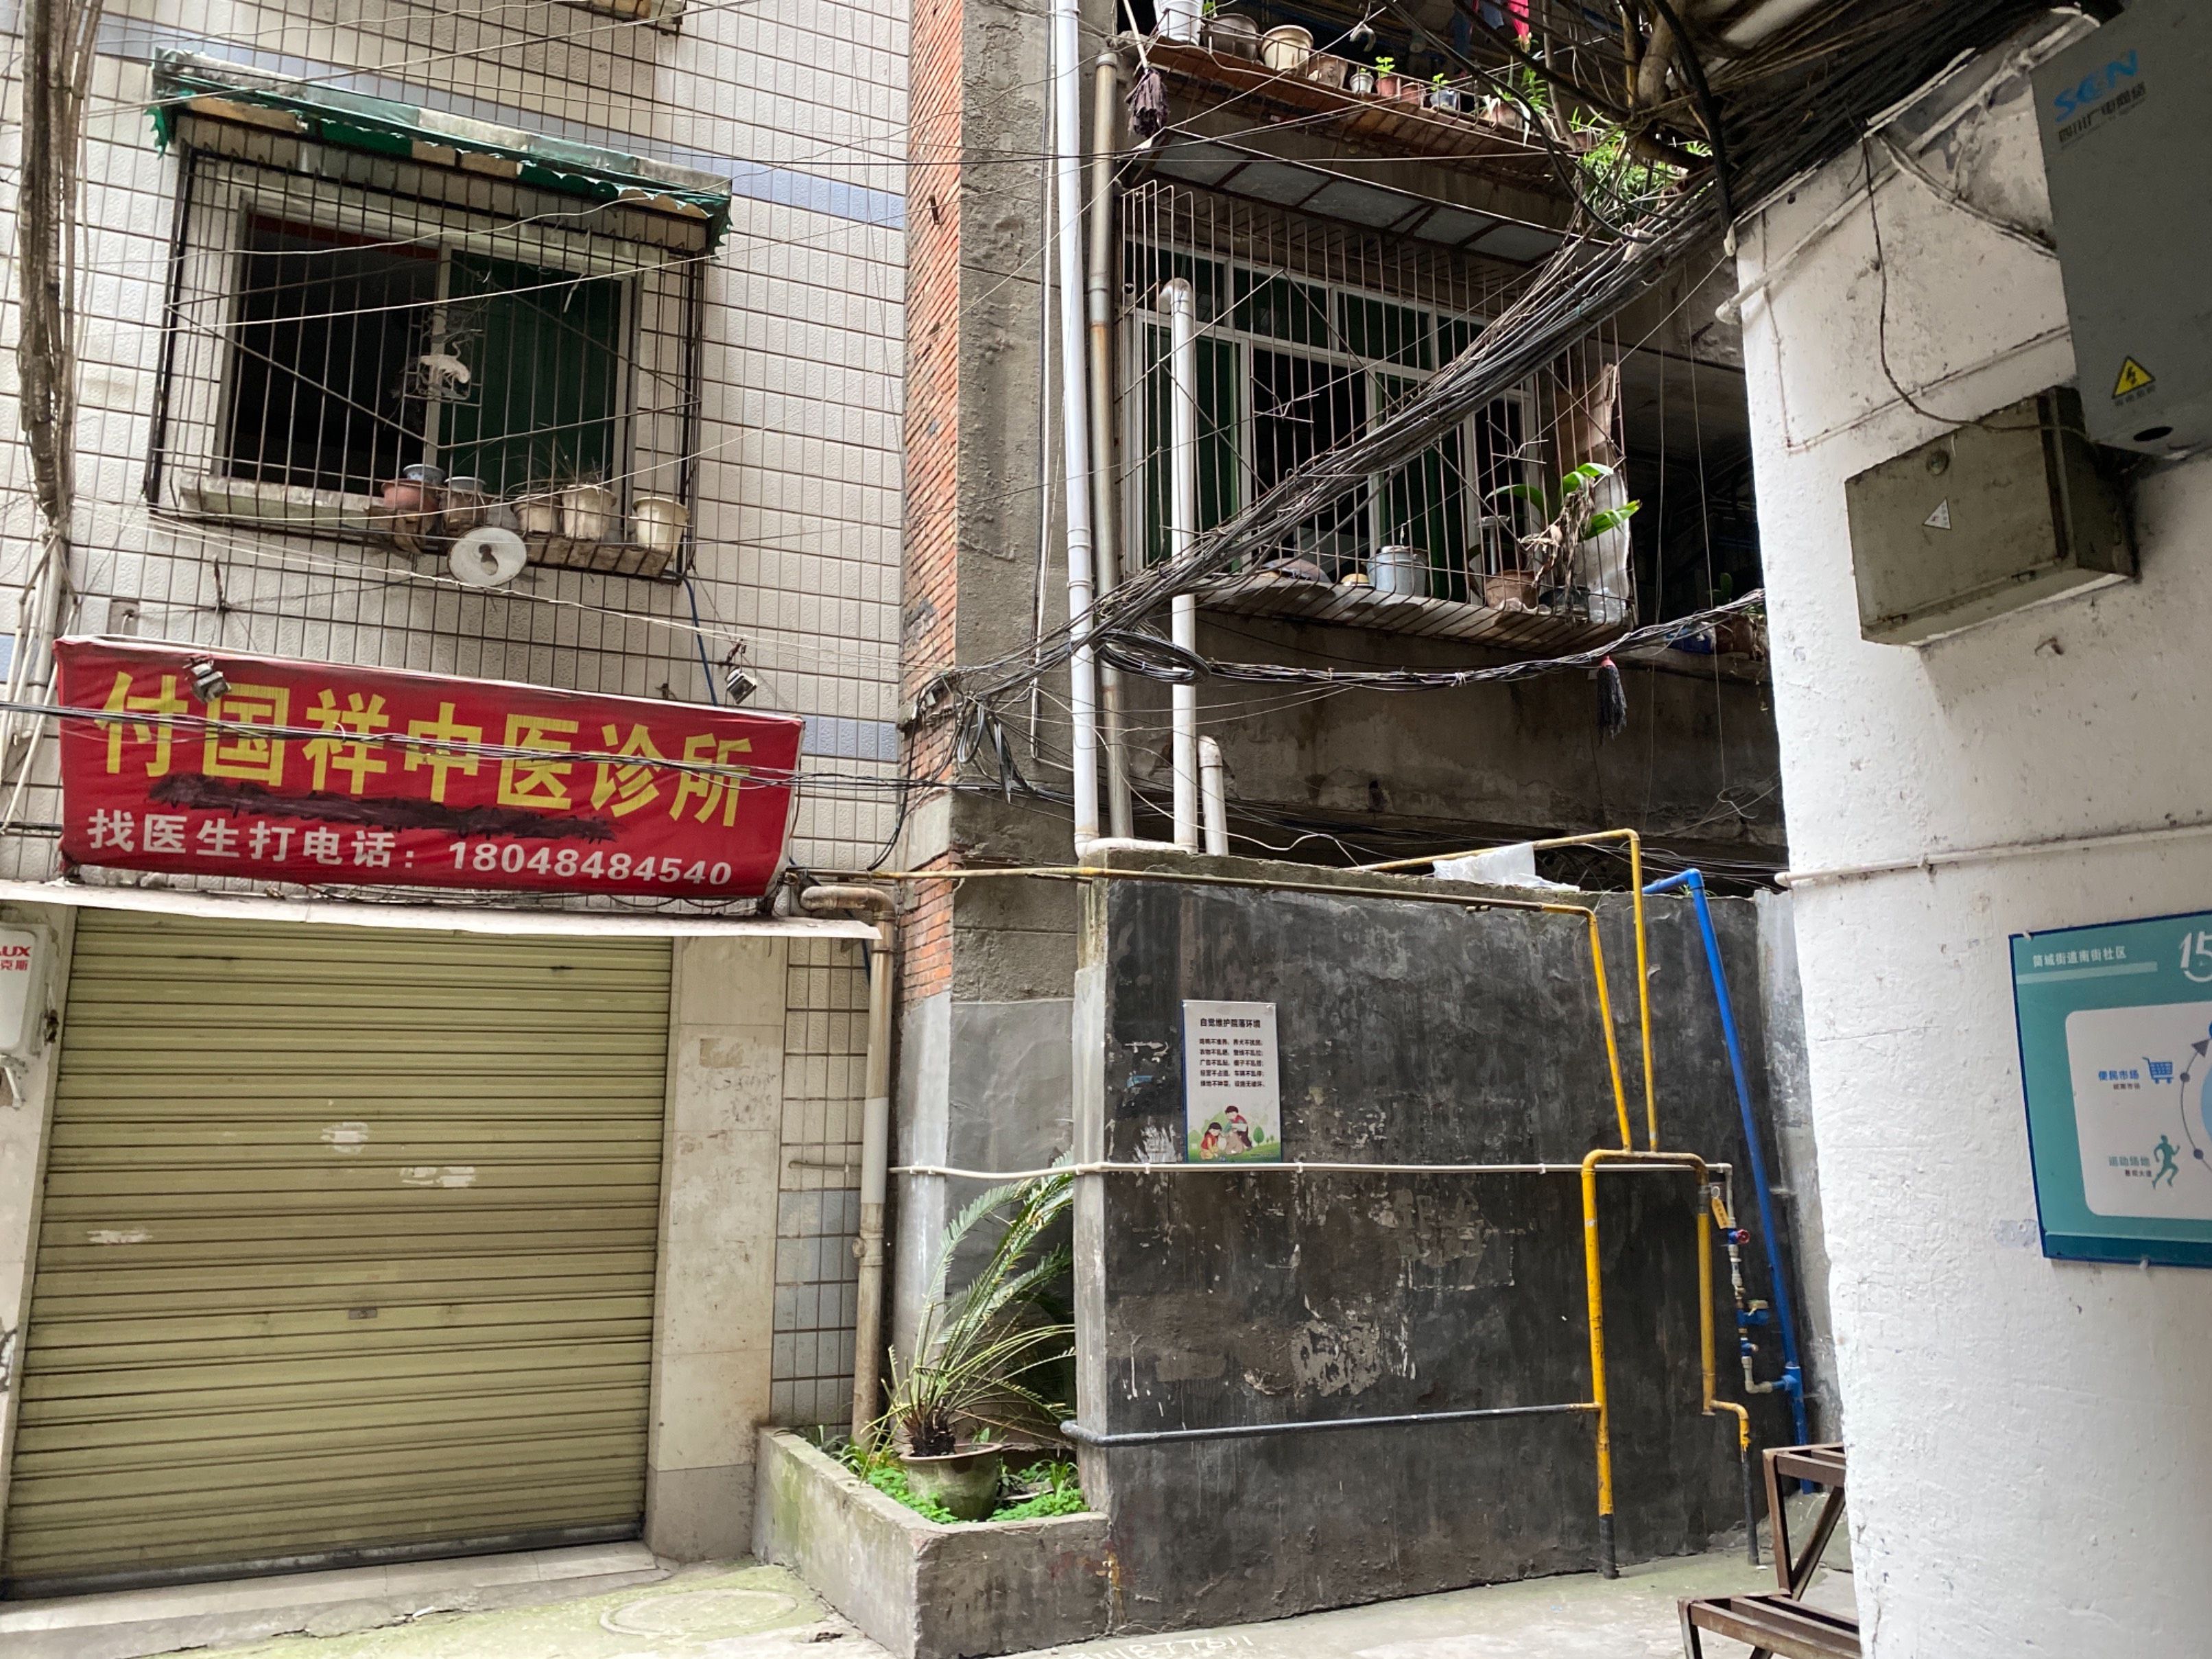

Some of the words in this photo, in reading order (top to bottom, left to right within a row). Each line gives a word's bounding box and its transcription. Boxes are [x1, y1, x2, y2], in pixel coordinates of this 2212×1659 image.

[93, 671, 752, 827] 付国祥中医诊所
[0, 946, 32, 957] UX
